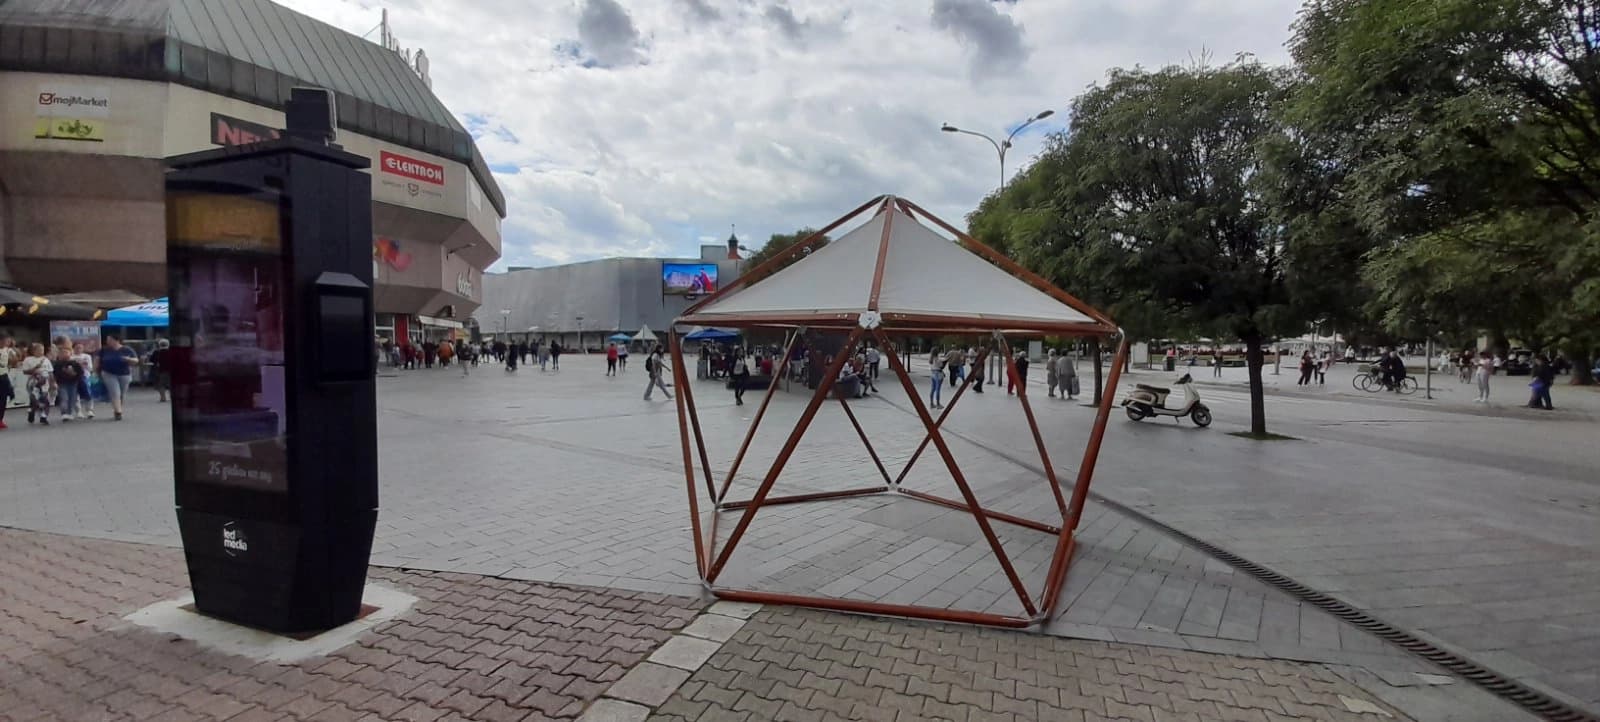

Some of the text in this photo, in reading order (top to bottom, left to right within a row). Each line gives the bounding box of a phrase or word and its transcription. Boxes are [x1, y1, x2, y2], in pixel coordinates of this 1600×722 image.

[53, 95, 108, 107] mojMarket
[385, 157, 442, 182] ELEKTRON
[208, 460, 222, 475] 25
[223, 527, 236, 540] led
[223, 539, 248, 551] media
